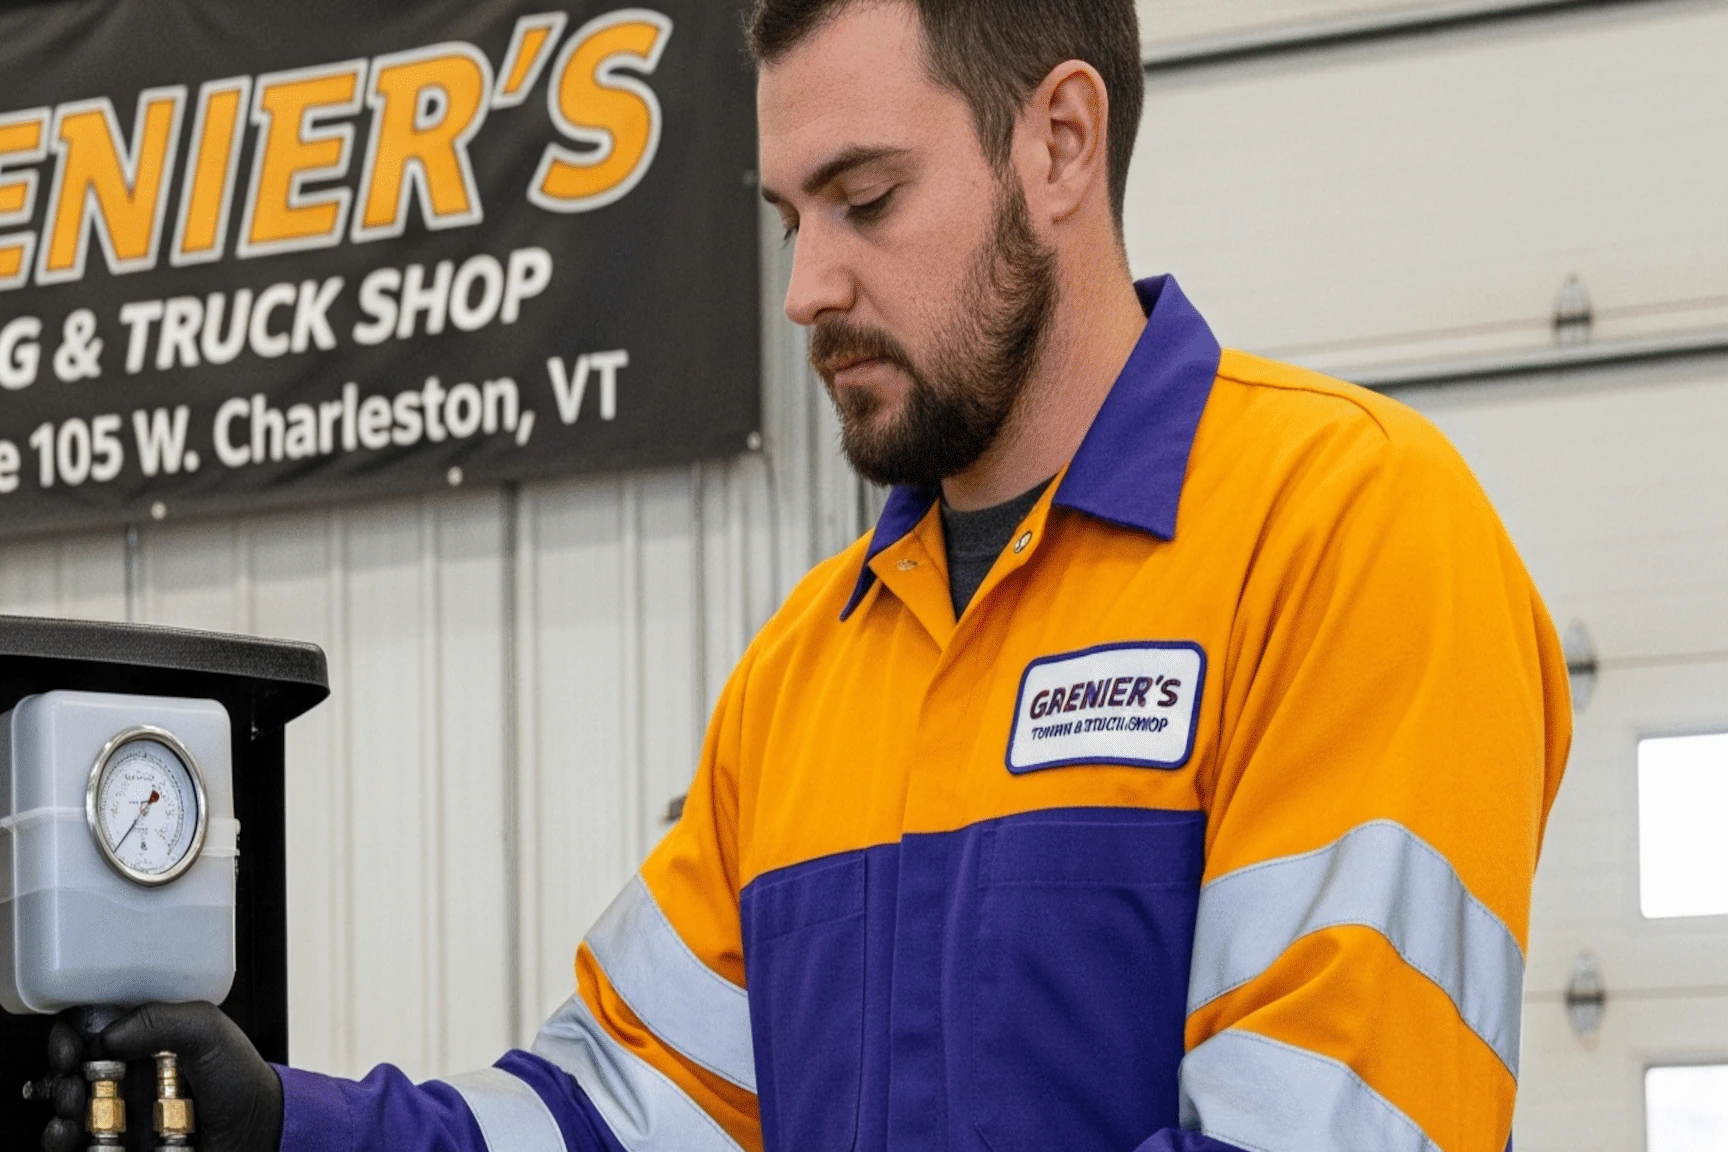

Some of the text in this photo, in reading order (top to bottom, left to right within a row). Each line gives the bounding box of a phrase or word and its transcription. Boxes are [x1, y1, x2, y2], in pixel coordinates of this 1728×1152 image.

[55, 311, 101, 383] &
[120, 277, 343, 371] TRUCK
[353, 247, 553, 341] SHOP
[30, 416, 124, 487] 105
[135, 405, 200, 475] W.
[213, 372, 537, 464] Charleston,
[547, 351, 629, 423] VT
